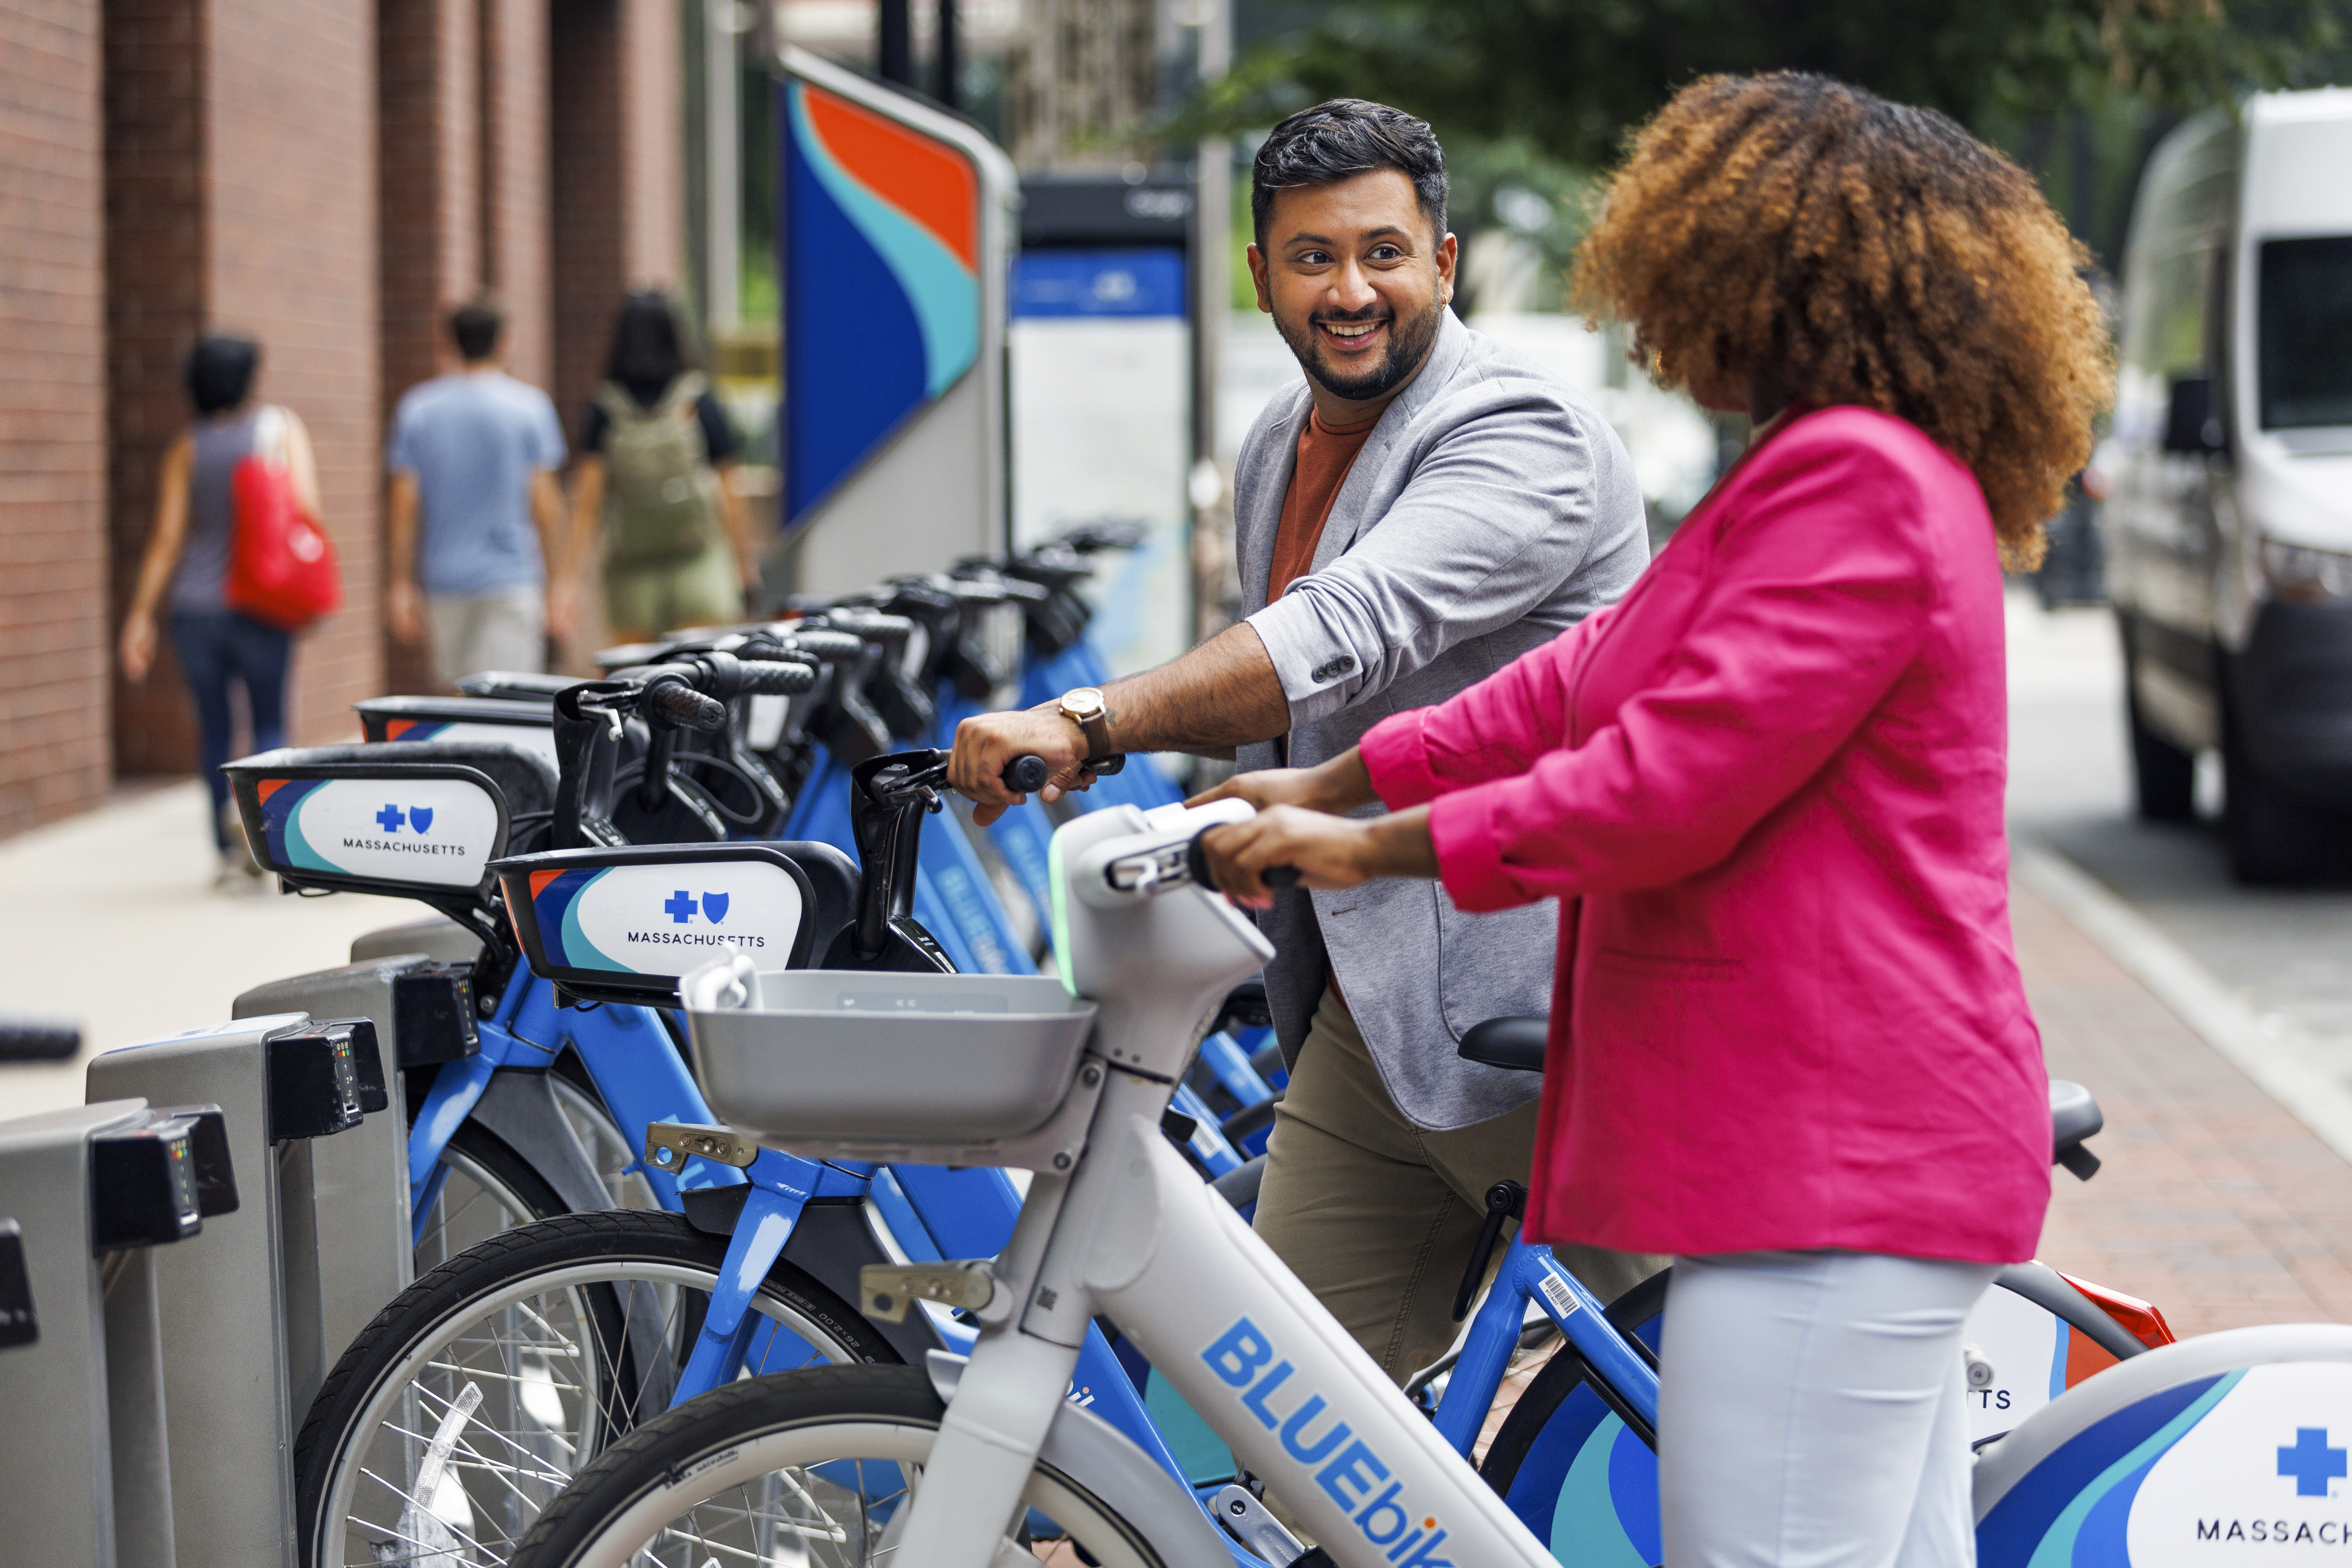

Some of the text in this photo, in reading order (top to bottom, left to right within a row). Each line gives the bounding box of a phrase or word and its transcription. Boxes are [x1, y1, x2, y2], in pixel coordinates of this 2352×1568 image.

[344, 838, 465, 856] MASSACHUSETTS
[628, 931, 764, 947] MASSACHUSETTS
[1545, 1289, 1558, 1305] 872-6457
